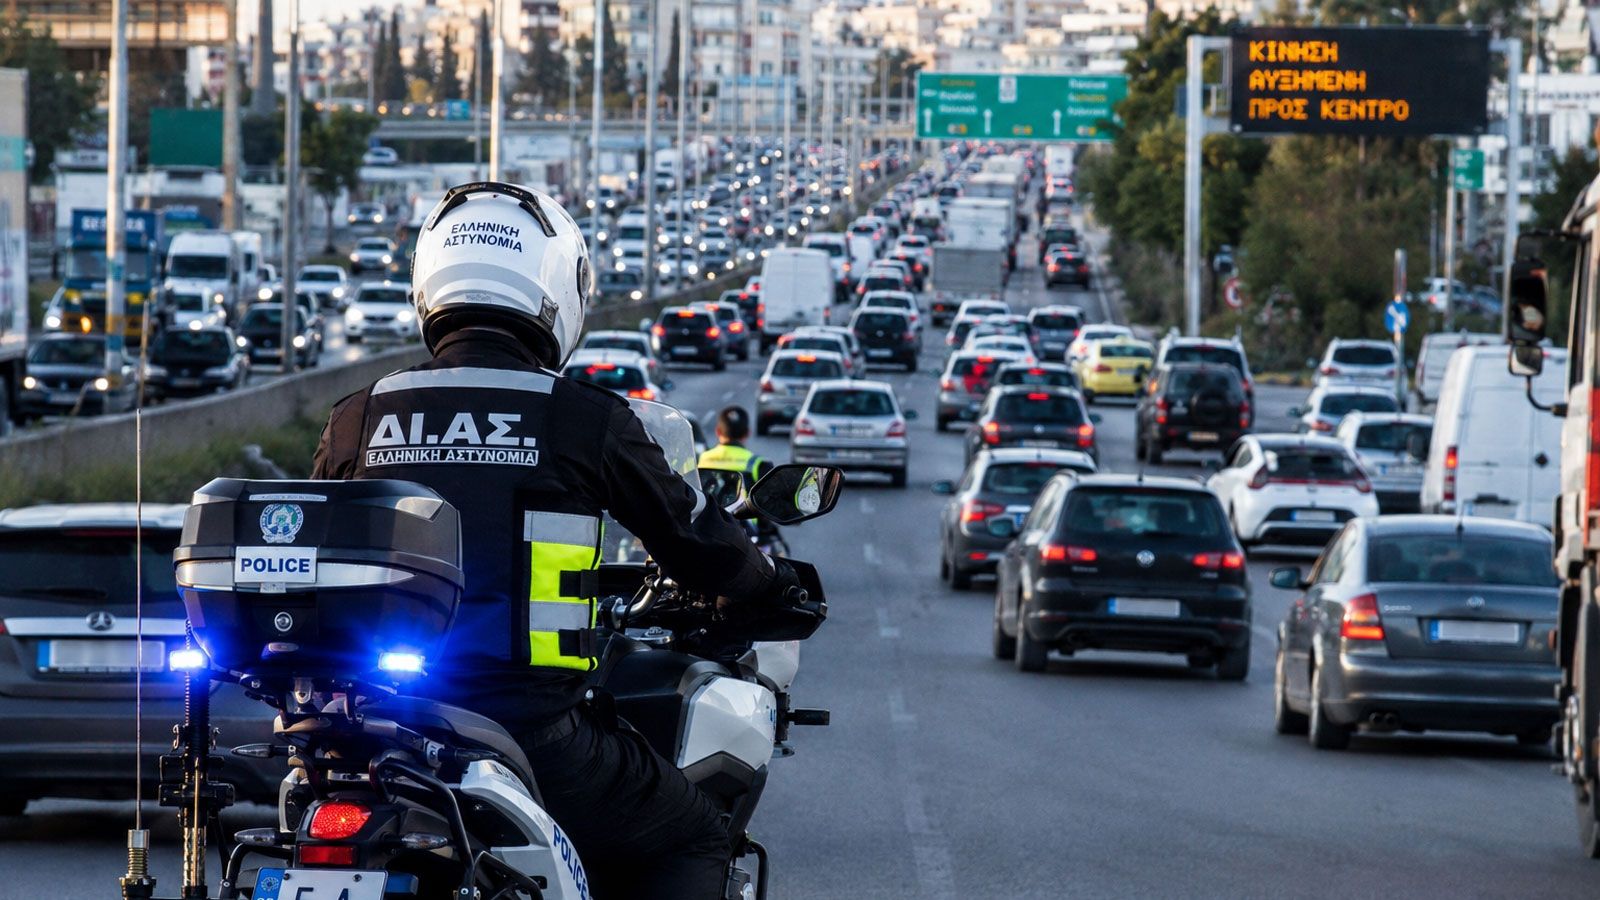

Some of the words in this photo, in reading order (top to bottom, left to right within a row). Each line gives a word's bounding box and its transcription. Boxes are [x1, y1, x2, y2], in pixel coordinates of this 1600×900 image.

[1249, 40, 1338, 62] ΚΙΝΗΣΗ
[1249, 69, 1367, 92] ΑΥΞΗΜΕΝΗ
[1249, 98, 1309, 120] ΠΡΟΣ
[1320, 98, 1410, 121] ΚΕΝΤΡΟ
[451, 222, 520, 238] ΕΛΛΗΝΙΚΗ
[443, 233, 523, 253] ΑΣΤΥΝΟΜΙΑ
[368, 412, 536, 447] ΔΙ.ΑΣ.
[445, 449, 536, 464] ΑΣΤΥΝΟΜΙΑ
[241, 558, 311, 573] POLICE
